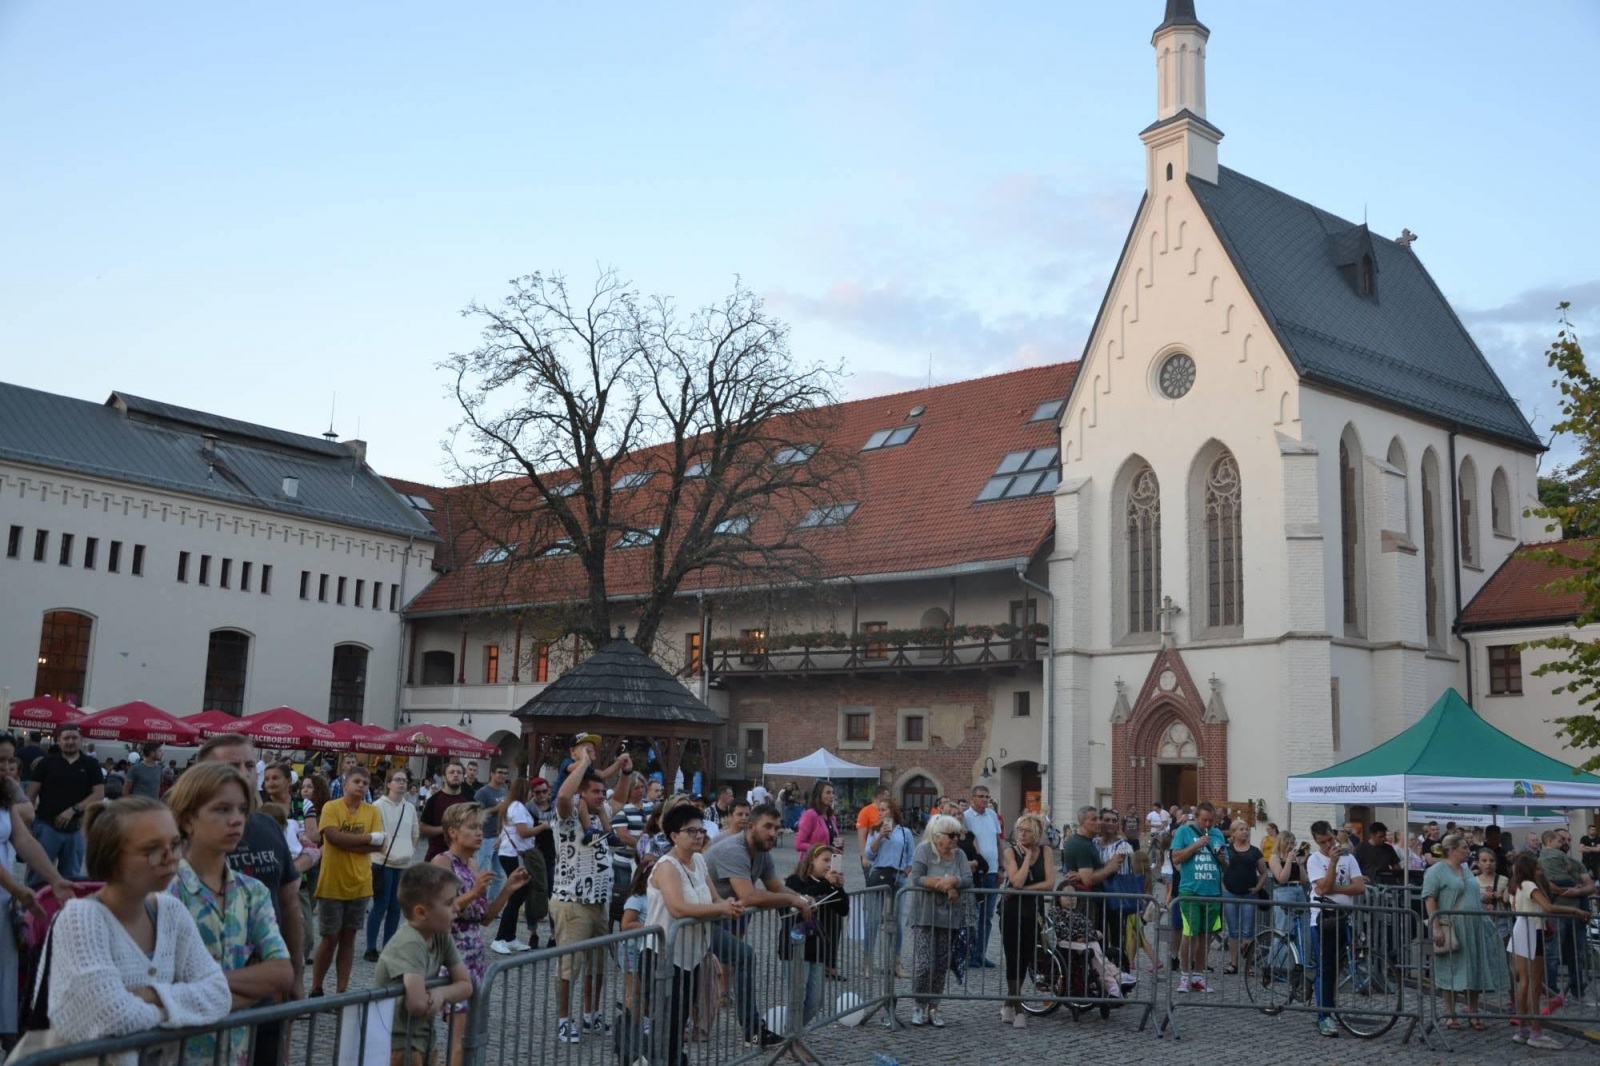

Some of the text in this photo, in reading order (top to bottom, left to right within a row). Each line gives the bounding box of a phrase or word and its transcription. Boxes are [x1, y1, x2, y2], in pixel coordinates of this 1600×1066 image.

[249, 733, 301, 745] RACIBORSKIE
[1000, 747, 1007, 758] D
[1309, 782, 1378, 794] www.powiatraciborski.pl
[226, 850, 279, 867] ITCHER
[1194, 854, 1212, 862] FOR
[1194, 863, 1217, 871] WEEK
